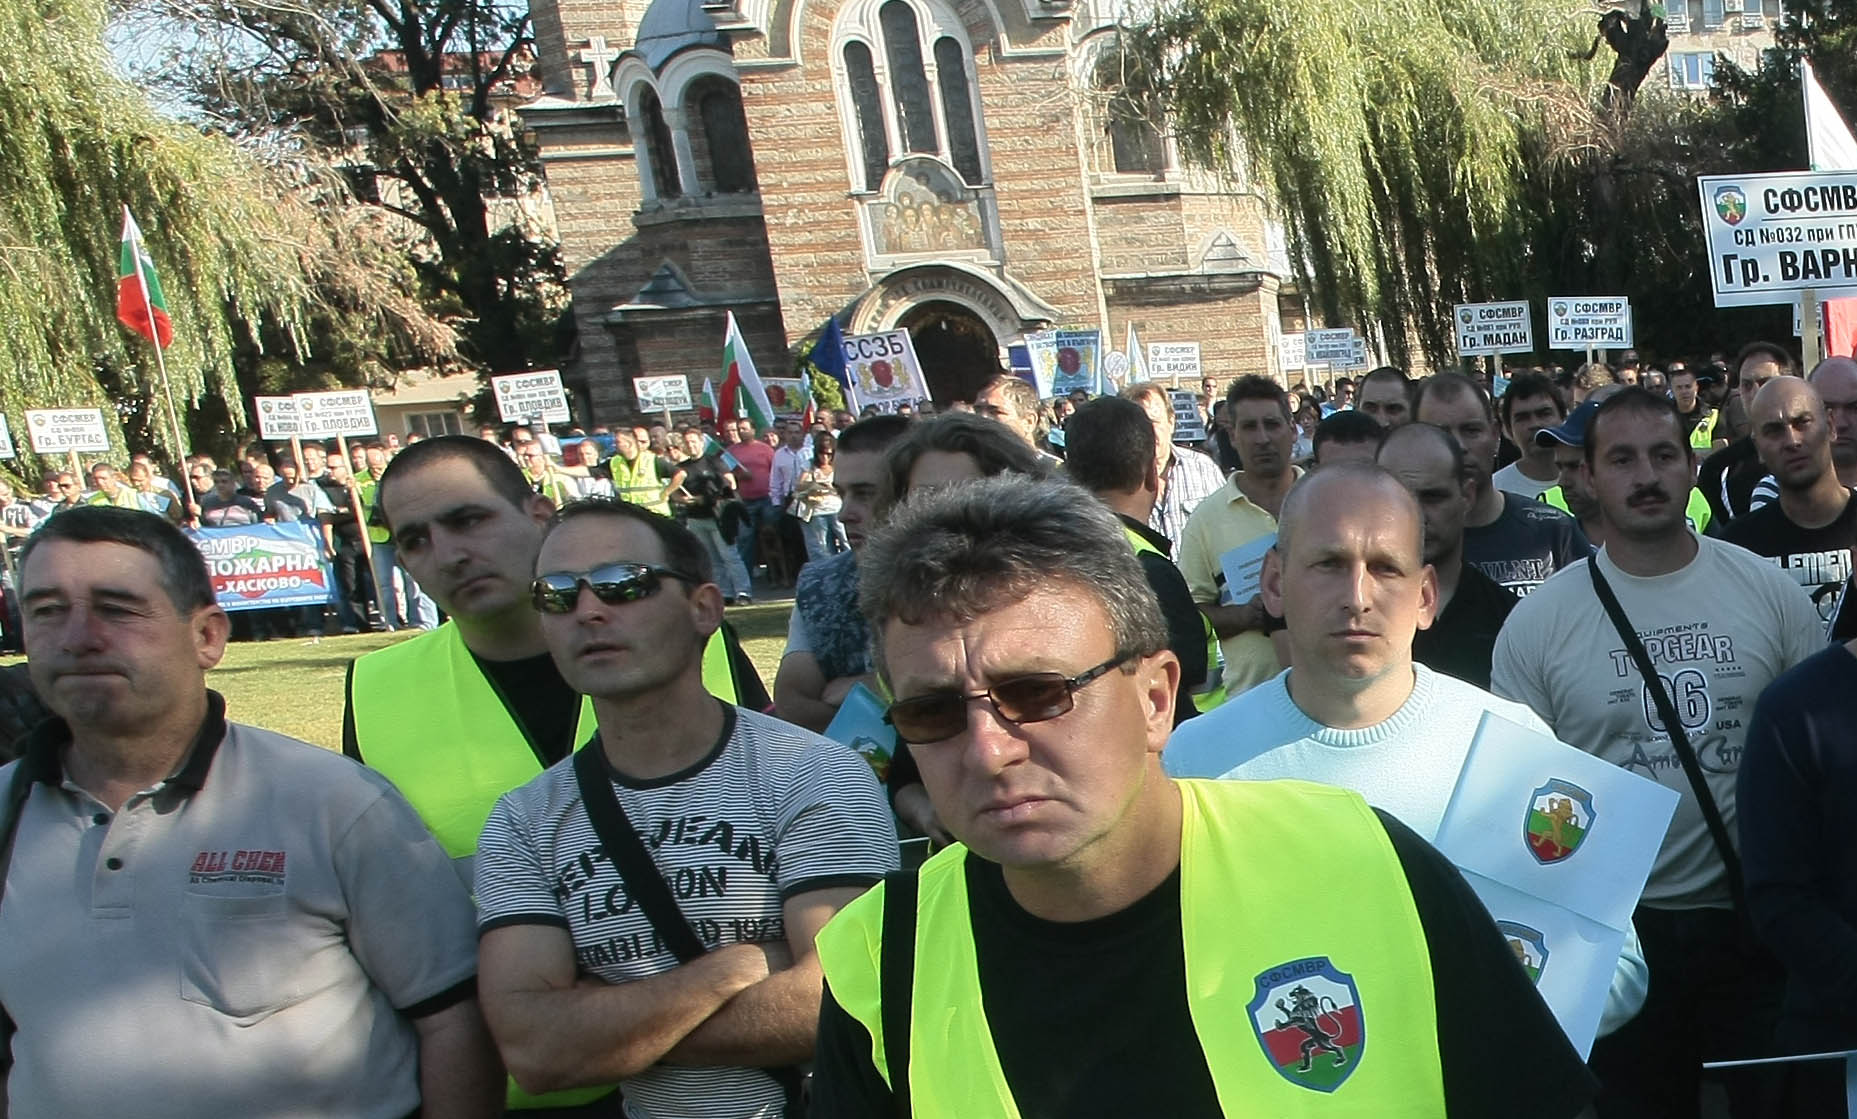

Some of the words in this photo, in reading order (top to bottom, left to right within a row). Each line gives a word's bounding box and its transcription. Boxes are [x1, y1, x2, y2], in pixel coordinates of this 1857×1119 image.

[1734, 228, 1757, 248] СД
[1759, 226, 1804, 245] №032
[1807, 226, 1834, 244] при
[1722, 253, 1770, 288] Гр.
[1479, 306, 1525, 320] СФСМВР
[1574, 302, 1623, 314] СФСМВР
[1462, 336, 1480, 349] Гр.
[1483, 331, 1527, 346] МАДАН
[1554, 328, 1571, 342] Гр.
[1574, 327, 1624, 342] РАЗГРАД
[845, 334, 904, 362] ССЗБ
[1166, 362, 1198, 372] ВИДИН
[519, 397, 563, 412] ПЛОВДИВ
[305, 421, 320, 432] Гр.
[323, 417, 371, 430] ПЛОВДИВ
[57, 434, 103, 445] БУРГАС
[1716, 719, 1742, 731] USA
[190, 851, 228, 872] ALL
[582, 866, 728, 925] LOON
[1259, 960, 1326, 989] СФСМВР
